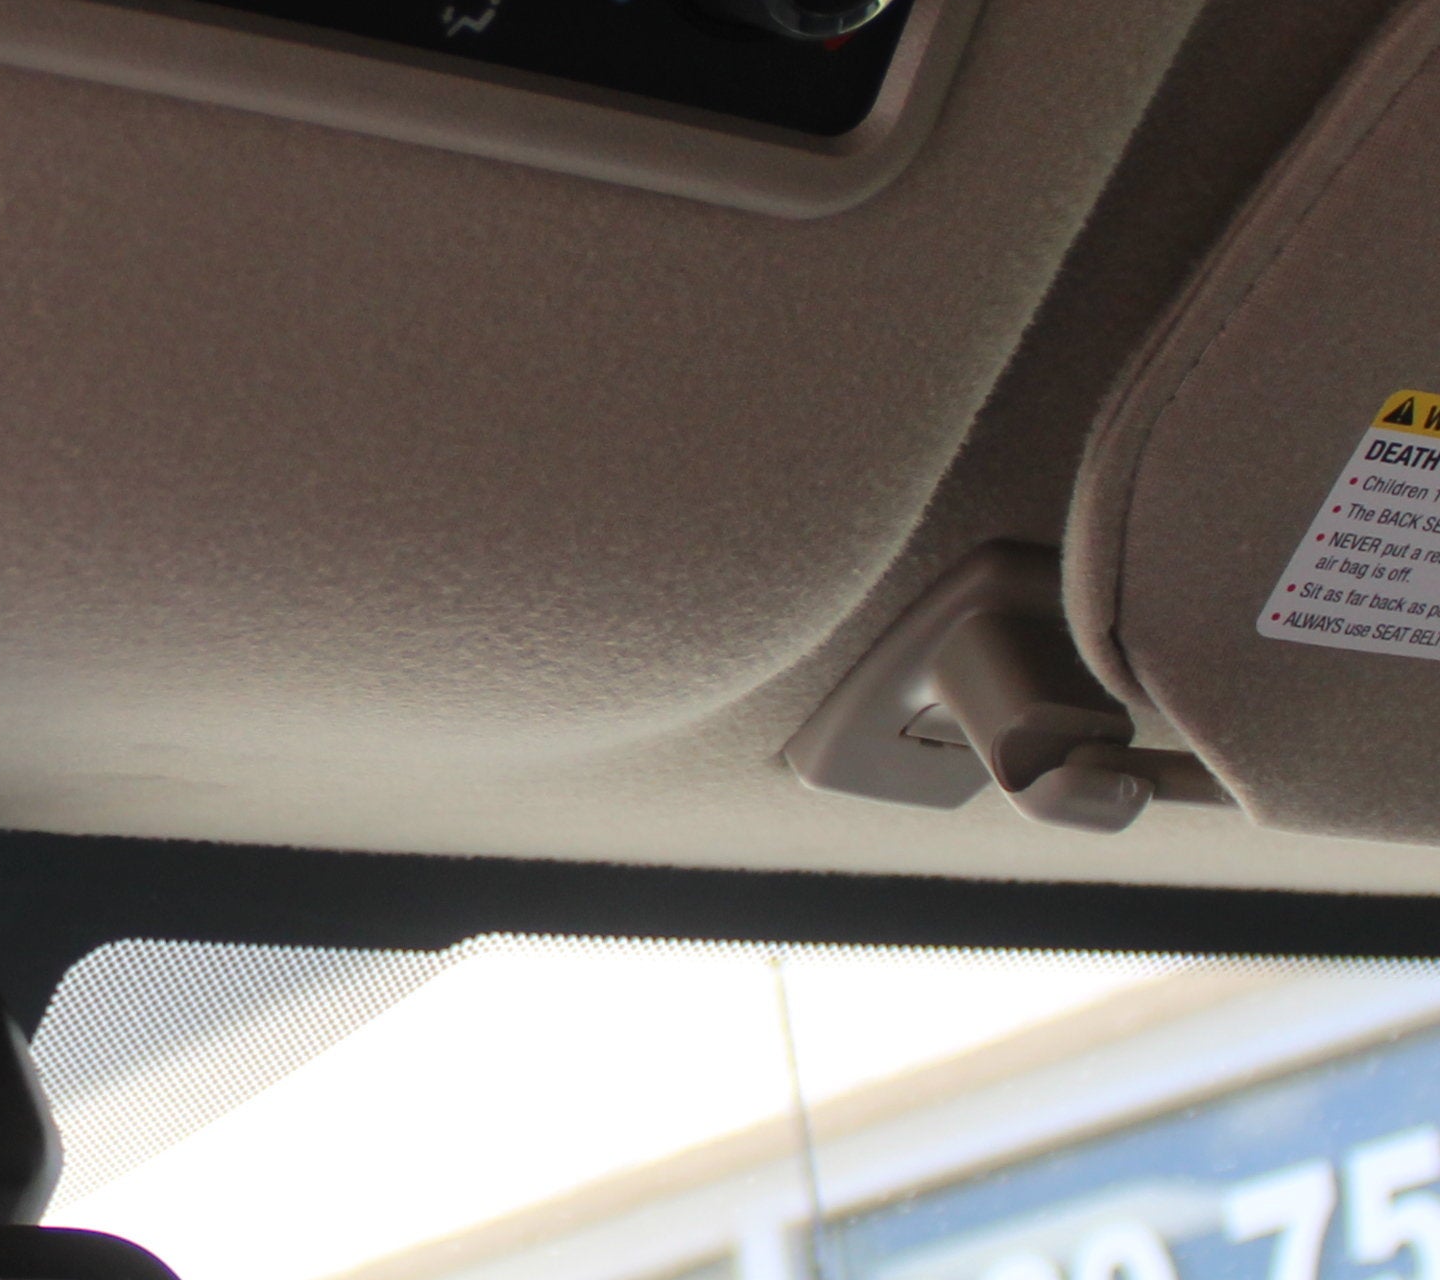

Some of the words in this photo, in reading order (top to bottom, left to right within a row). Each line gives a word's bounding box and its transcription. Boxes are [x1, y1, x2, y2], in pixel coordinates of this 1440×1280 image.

[1362, 474, 1430, 501] Children
[1347, 502, 1376, 522] The
[1376, 508, 1424, 530] BACK
[1327, 531, 1383, 554] NEVER
[1379, 542, 1411, 559] put
[1409, 547, 1423, 561] a
[1314, 555, 1340, 571] air
[1338, 557, 1371, 580] bag
[1370, 562, 1387, 580] is
[1387, 566, 1413, 583] off.
[1299, 581, 1324, 600] Sit
[1322, 588, 1344, 604] as
[1344, 589, 1370, 607] far
[1368, 593, 1407, 613] back
[1406, 601, 1428, 616] as
[1282, 610, 1346, 634] ALWAYS
[1343, 623, 1372, 638] use
[1371, 623, 1412, 642] SEAT
